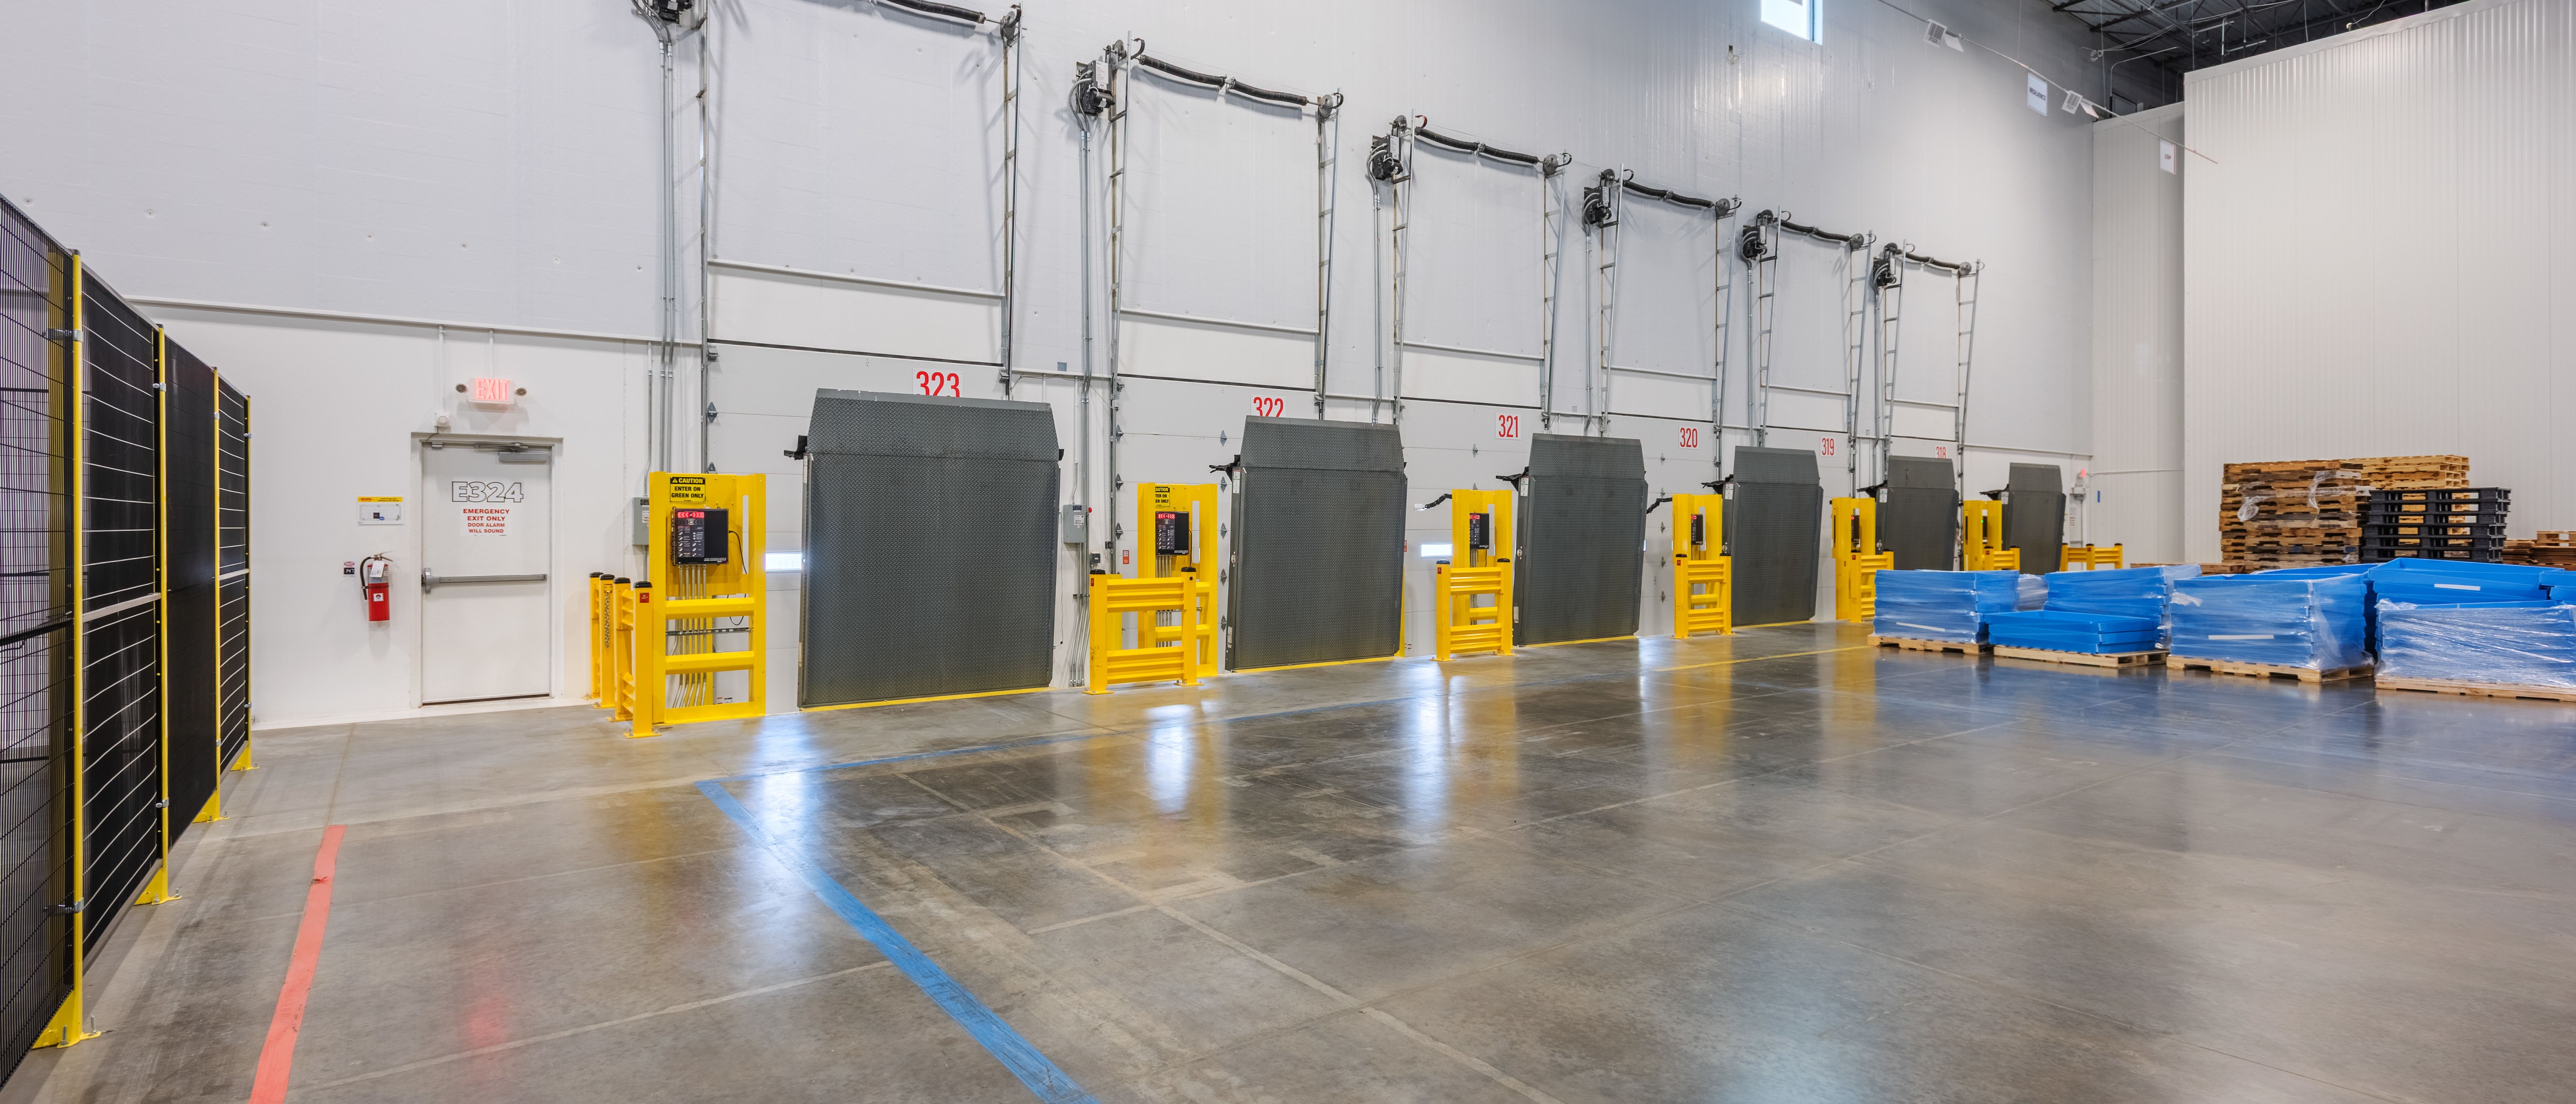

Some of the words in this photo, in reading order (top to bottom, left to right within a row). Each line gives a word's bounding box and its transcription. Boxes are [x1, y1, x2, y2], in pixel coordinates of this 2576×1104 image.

[2030, 87, 2046, 101] RESILIENCE
[475, 378, 509, 401] EXIT
[916, 371, 960, 397] 323
[1254, 397, 1283, 417] 322
[1499, 415, 1518, 438] 321
[1680, 428, 1697, 448] 320
[1822, 438, 1834, 455] 319
[1936, 446, 1946, 459] 318
[452, 482, 523, 502] E324
